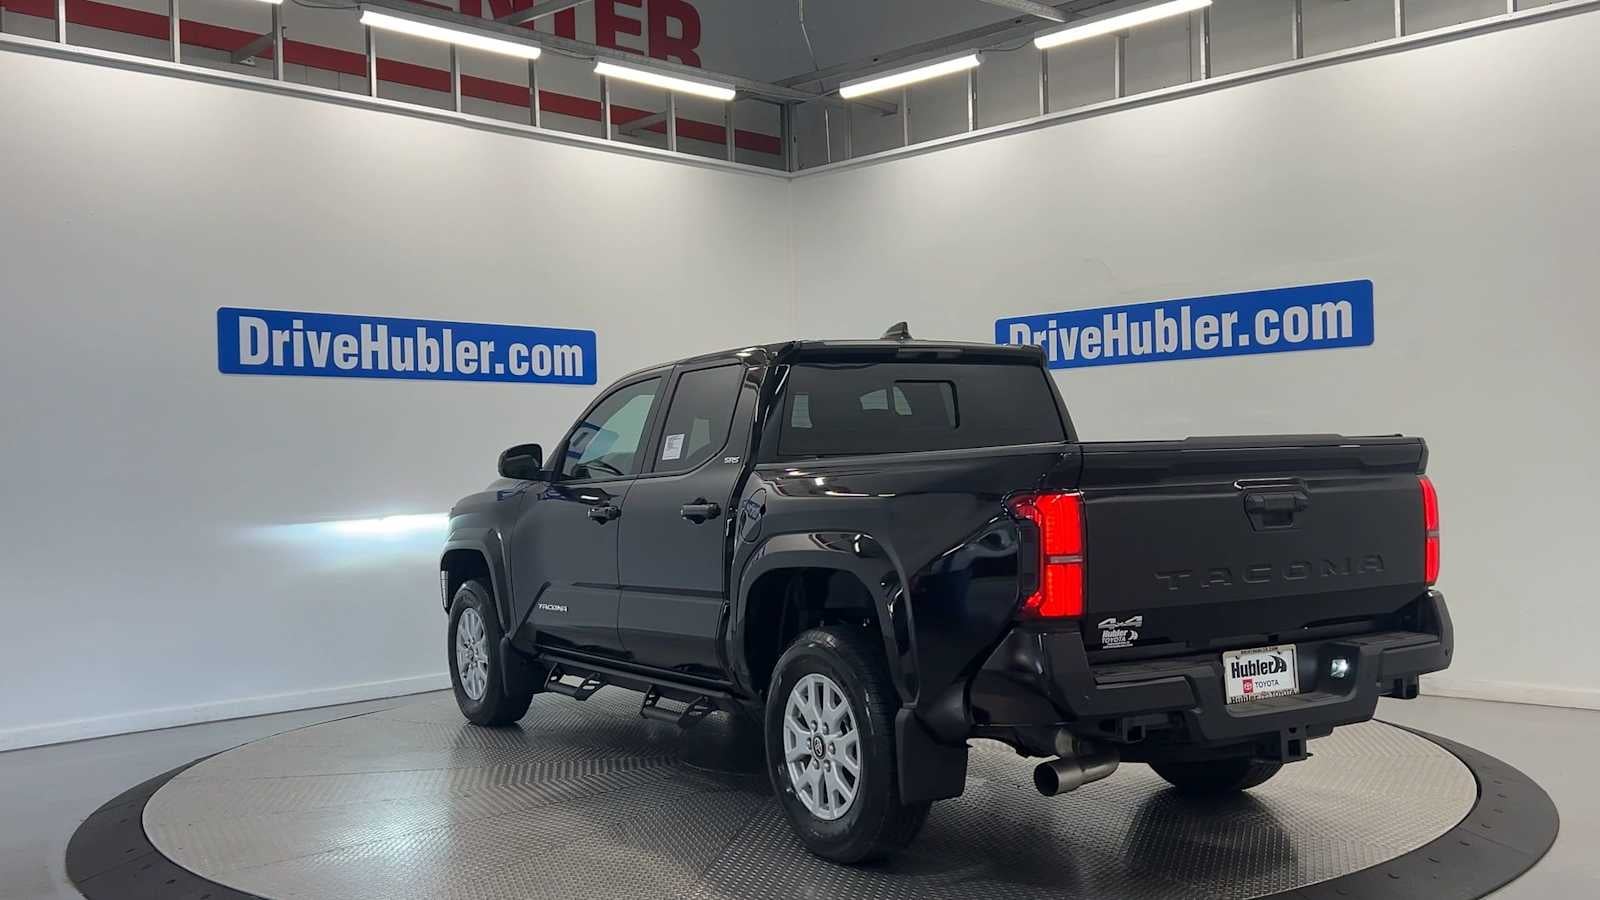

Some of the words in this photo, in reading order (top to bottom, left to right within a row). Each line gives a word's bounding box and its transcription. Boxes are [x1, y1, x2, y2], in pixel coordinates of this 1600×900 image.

[238, 315, 584, 377] DriveHubler.com
[1154, 553, 1385, 591] TACOMA
[1102, 629, 1129, 639] Hubler
[1231, 659, 1275, 679] Hubler
[1255, 679, 1279, 689] TOYOTA
